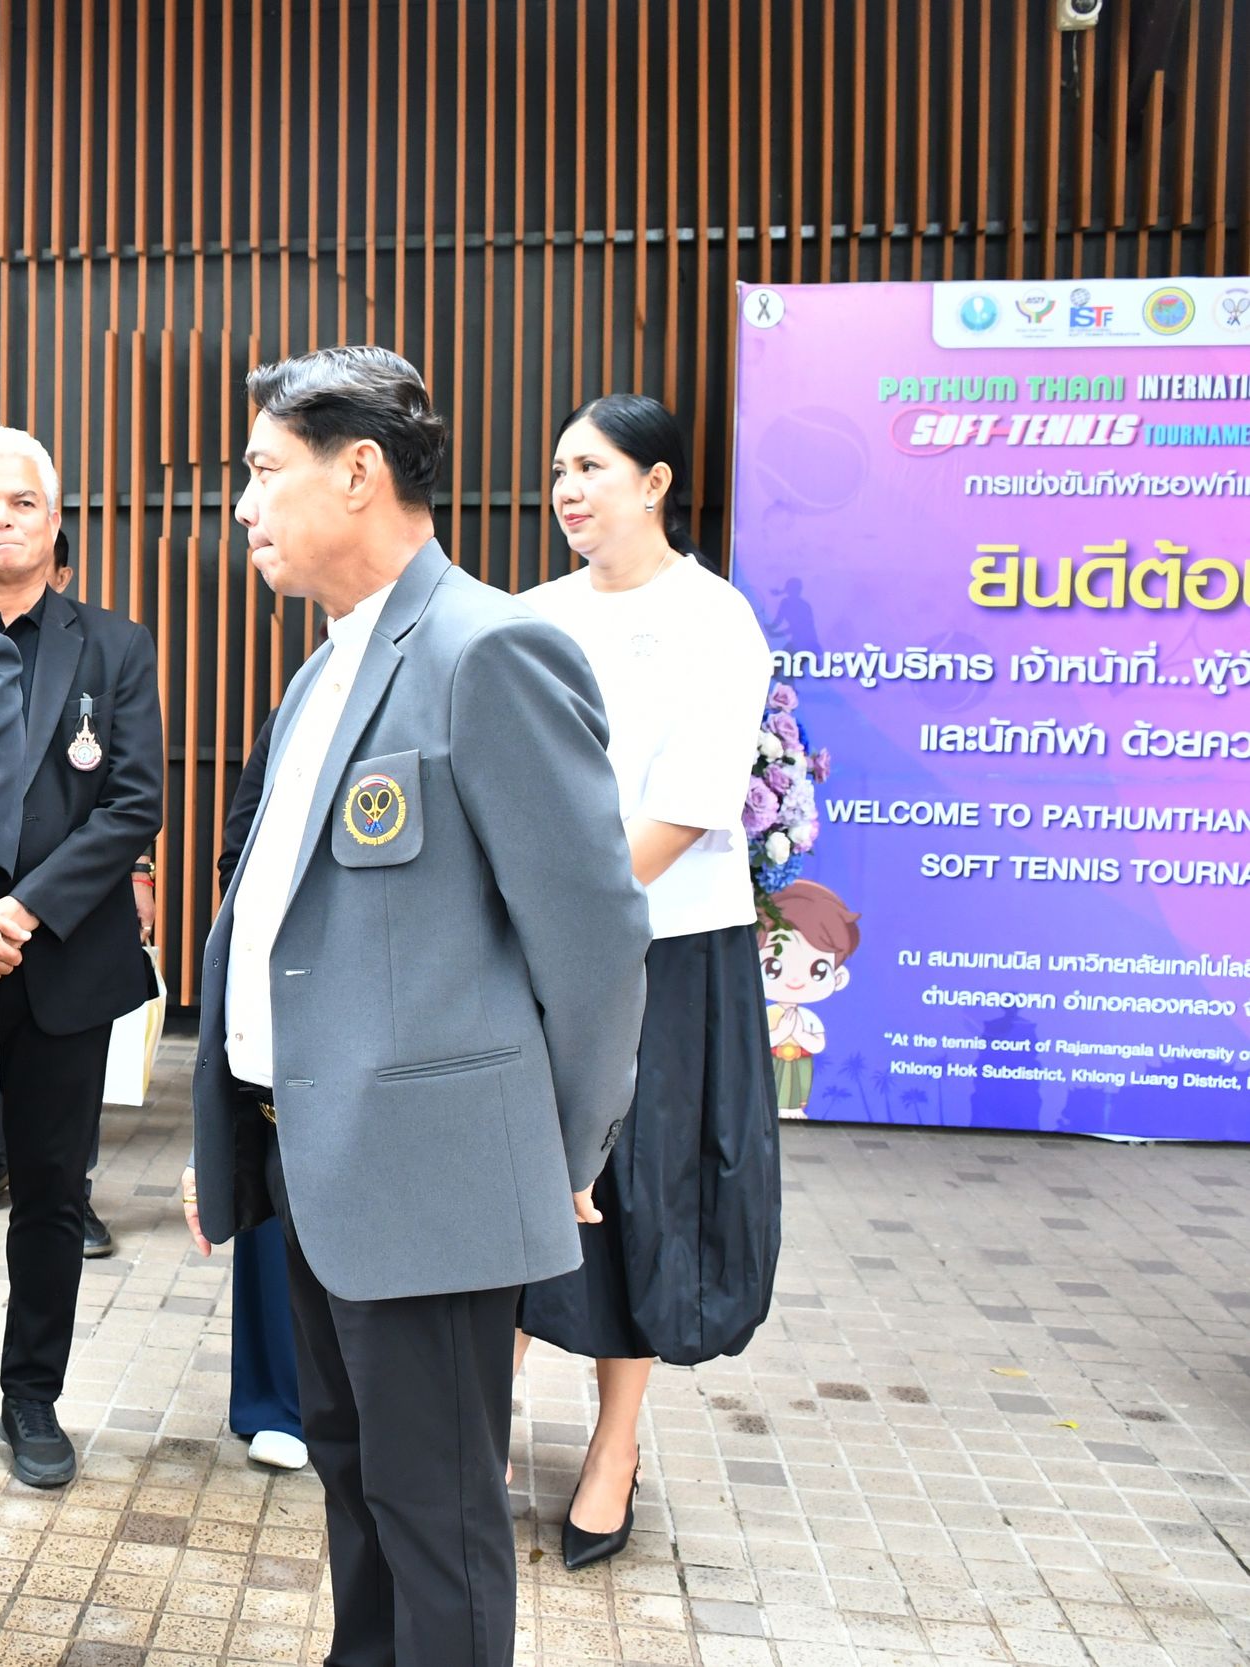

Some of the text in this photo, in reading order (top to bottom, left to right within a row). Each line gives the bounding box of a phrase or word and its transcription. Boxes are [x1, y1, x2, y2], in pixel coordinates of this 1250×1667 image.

[1069, 306, 1114, 328] ISTF
[878, 374, 1250, 402] PATHUM THANI INTERNATI
[909, 414, 1250, 446] SOFT TENNIS TOURNAME
[967, 538, 1250, 611] ยินดีต้อ
[770, 643, 994, 688] คณะผู้บริหาร
[920, 717, 1106, 755] และนักกีฬา
[825, 799, 1250, 833] WELCOME TO PATHUMTHAN
[920, 853, 1000, 878] SOFT
[1009, 856, 1120, 882] TENNIS
[898, 950, 921, 966] ณ
[927, 950, 1041, 970] สนามเทนนิส
[921, 984, 1056, 1009] ตำบลคลองหก
[1063, 990, 1236, 1016] อำเภอคลองหลวง
[913, 1034, 938, 1048] the
[941, 1036, 987, 1050] tennis
[990, 1039, 1031, 1052] court
[1034, 1040, 1051, 1053] of
[1055, 1040, 1154, 1059] Rajamangala
[1158, 1044, 1235, 1064] University
[1238, 1049, 1250, 1062] o
[890, 1061, 943, 1079] Khlong
[947, 1063, 978, 1078] Hok
[981, 1064, 1067, 1083] Subdistrict,
[1071, 1069, 1126, 1087] Khlong
[1130, 1071, 1179, 1089] Luang
[1183, 1073, 1242, 1091] District,
